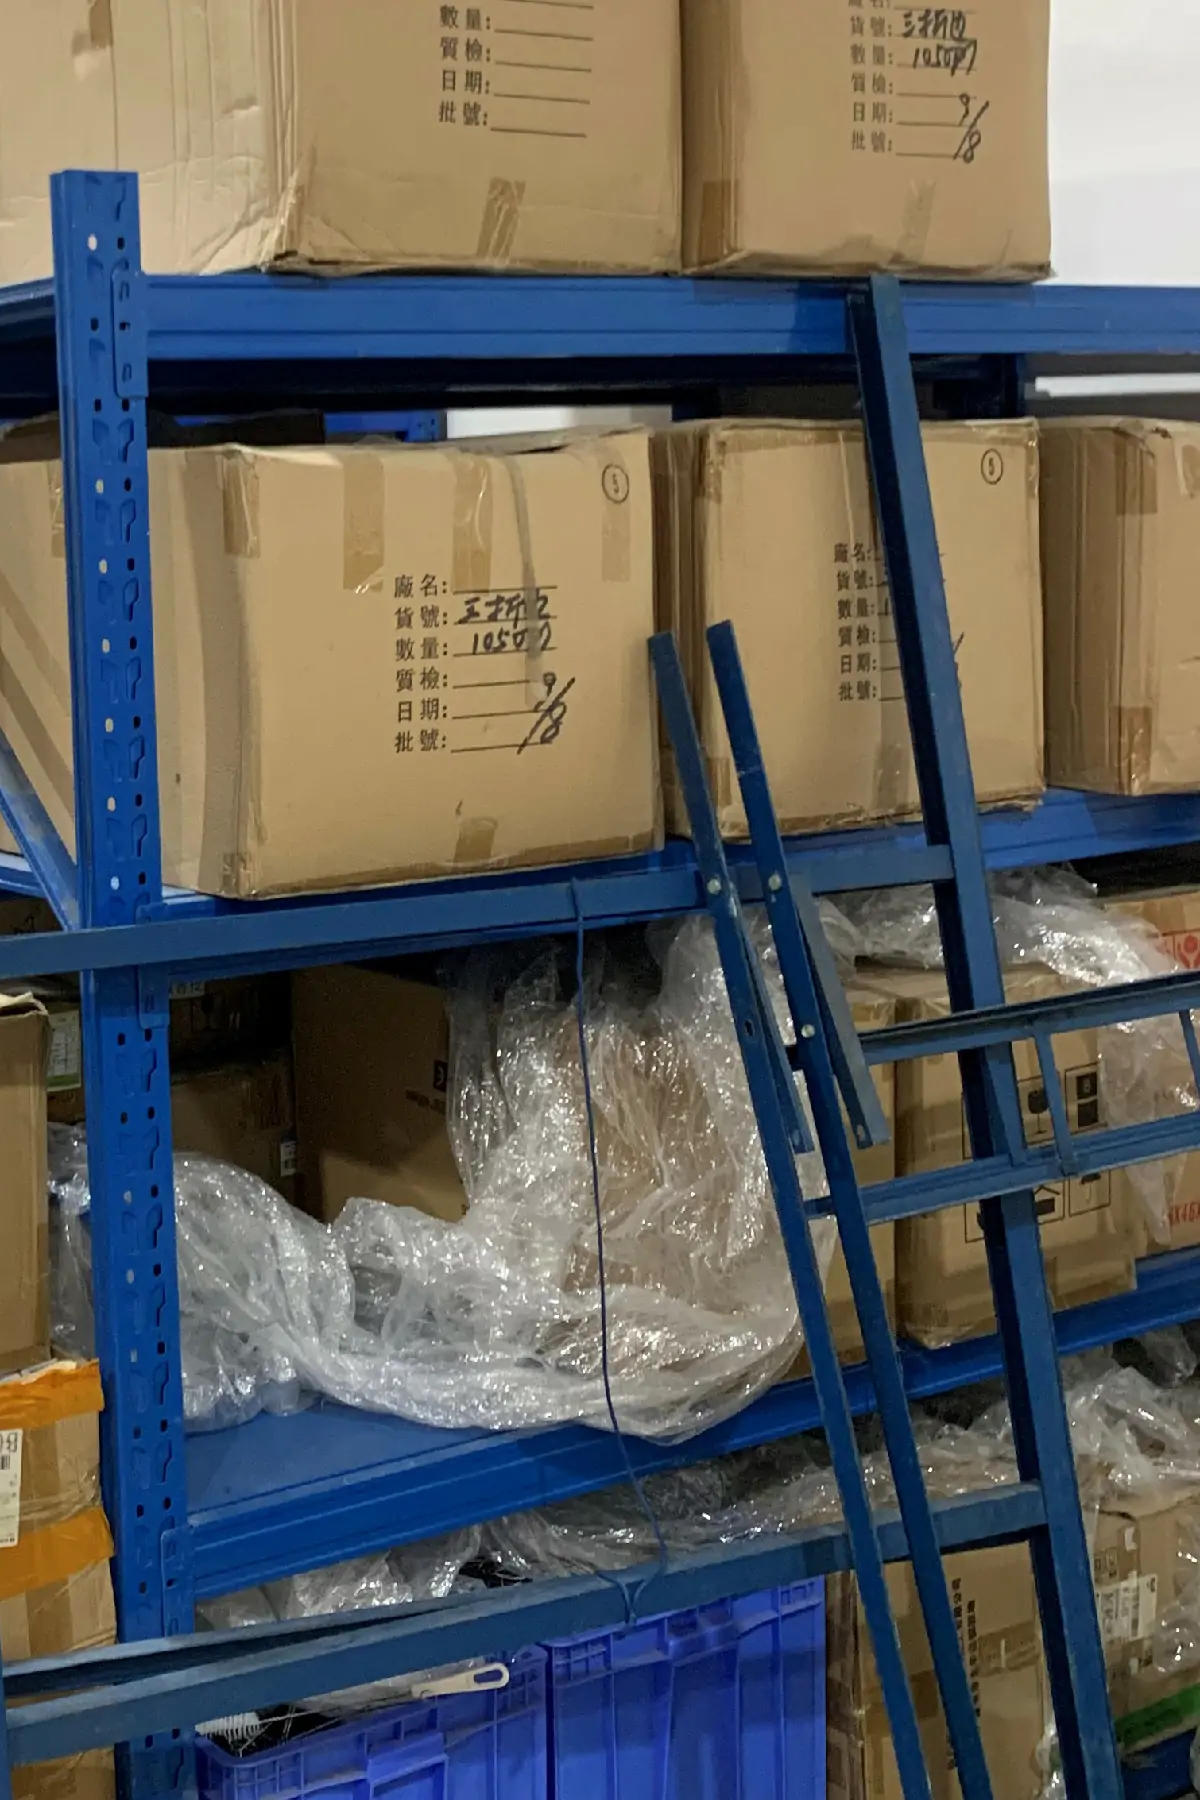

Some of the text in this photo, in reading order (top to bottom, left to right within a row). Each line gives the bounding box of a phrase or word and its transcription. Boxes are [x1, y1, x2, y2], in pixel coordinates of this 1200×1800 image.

[442, 69, 490, 95] 日期:
[438, 100, 488, 127] 批號:
[852, 101, 893, 124] 日期:
[397, 697, 448, 723] 日期:
[394, 728, 447, 753] 批號:
